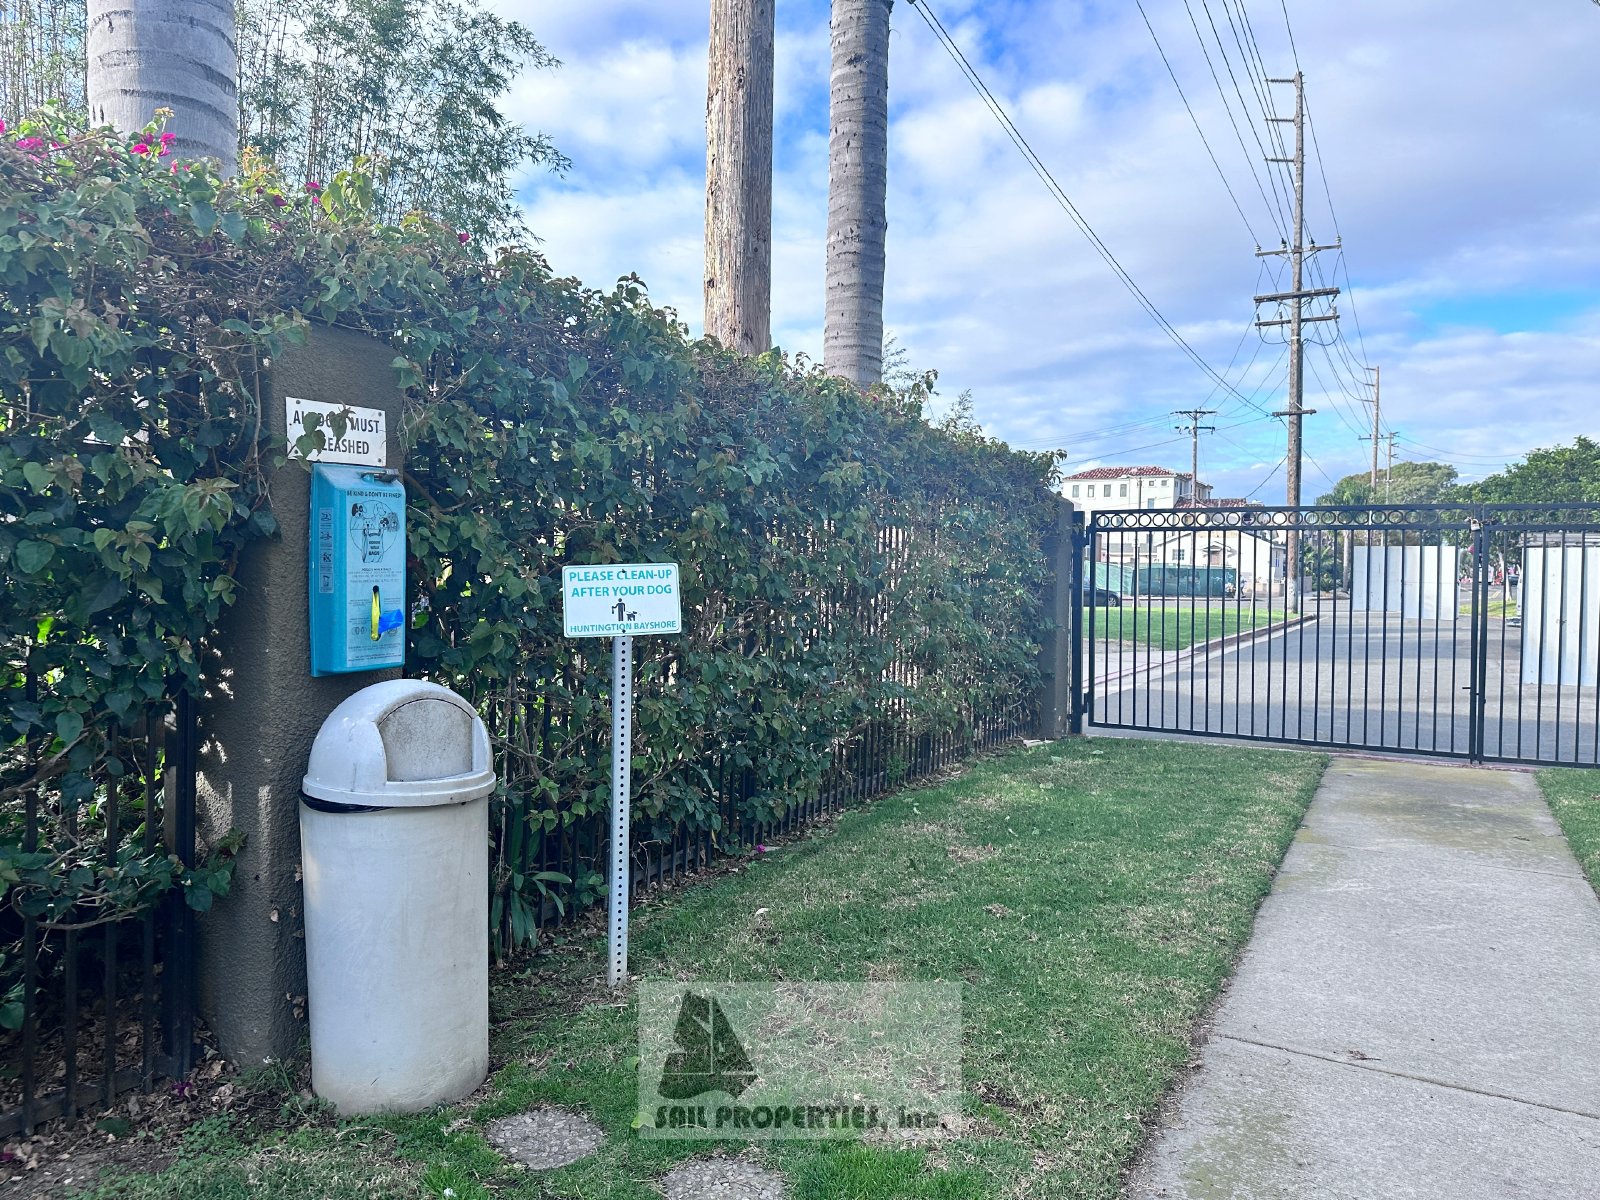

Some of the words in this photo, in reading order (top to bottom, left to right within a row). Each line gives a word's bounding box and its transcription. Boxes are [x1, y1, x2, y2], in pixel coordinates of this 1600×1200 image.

[322, 437, 370, 455] EASHED
[569, 571, 613, 582] PLEASE
[617, 569, 672, 580] CLEAN-UP
[571, 586, 610, 597] AFTER
[612, 585, 645, 596] YOUR
[647, 584, 672, 595] DOG
[634, 620, 677, 630] BAYSHORE
